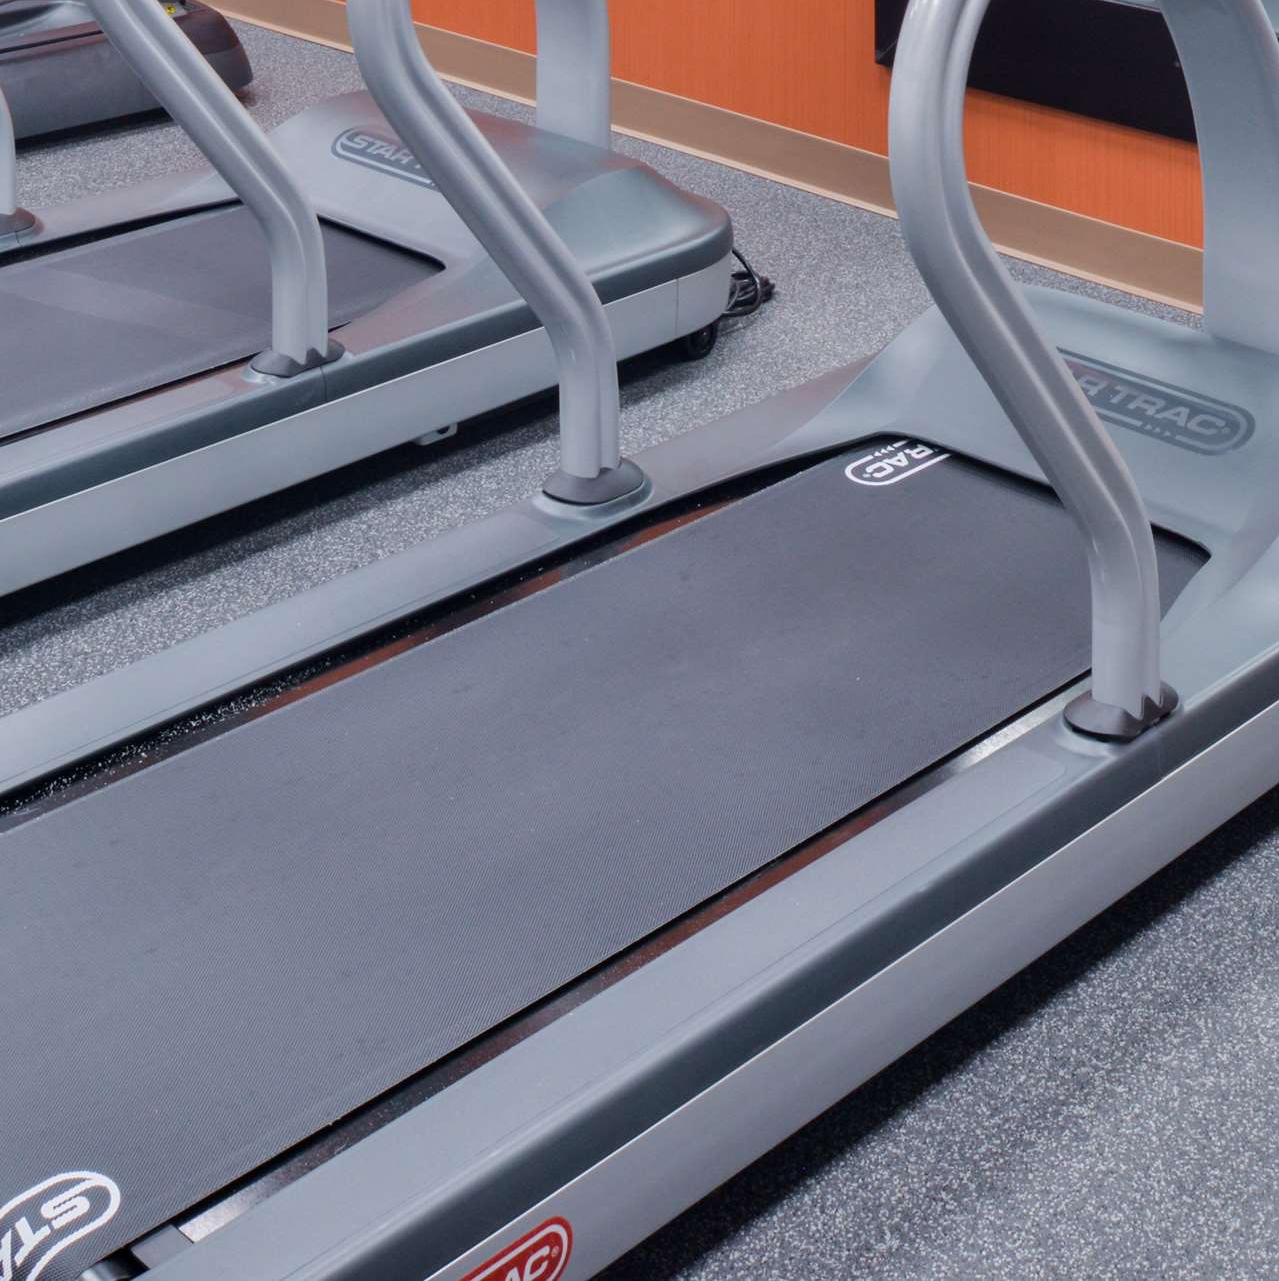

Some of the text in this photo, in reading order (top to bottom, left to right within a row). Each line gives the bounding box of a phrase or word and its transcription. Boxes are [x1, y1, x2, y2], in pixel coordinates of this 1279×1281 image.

[351, 134, 415, 165] STAR
[1109, 384, 1228, 436] TRAC
[865, 443, 937, 479] RAC
